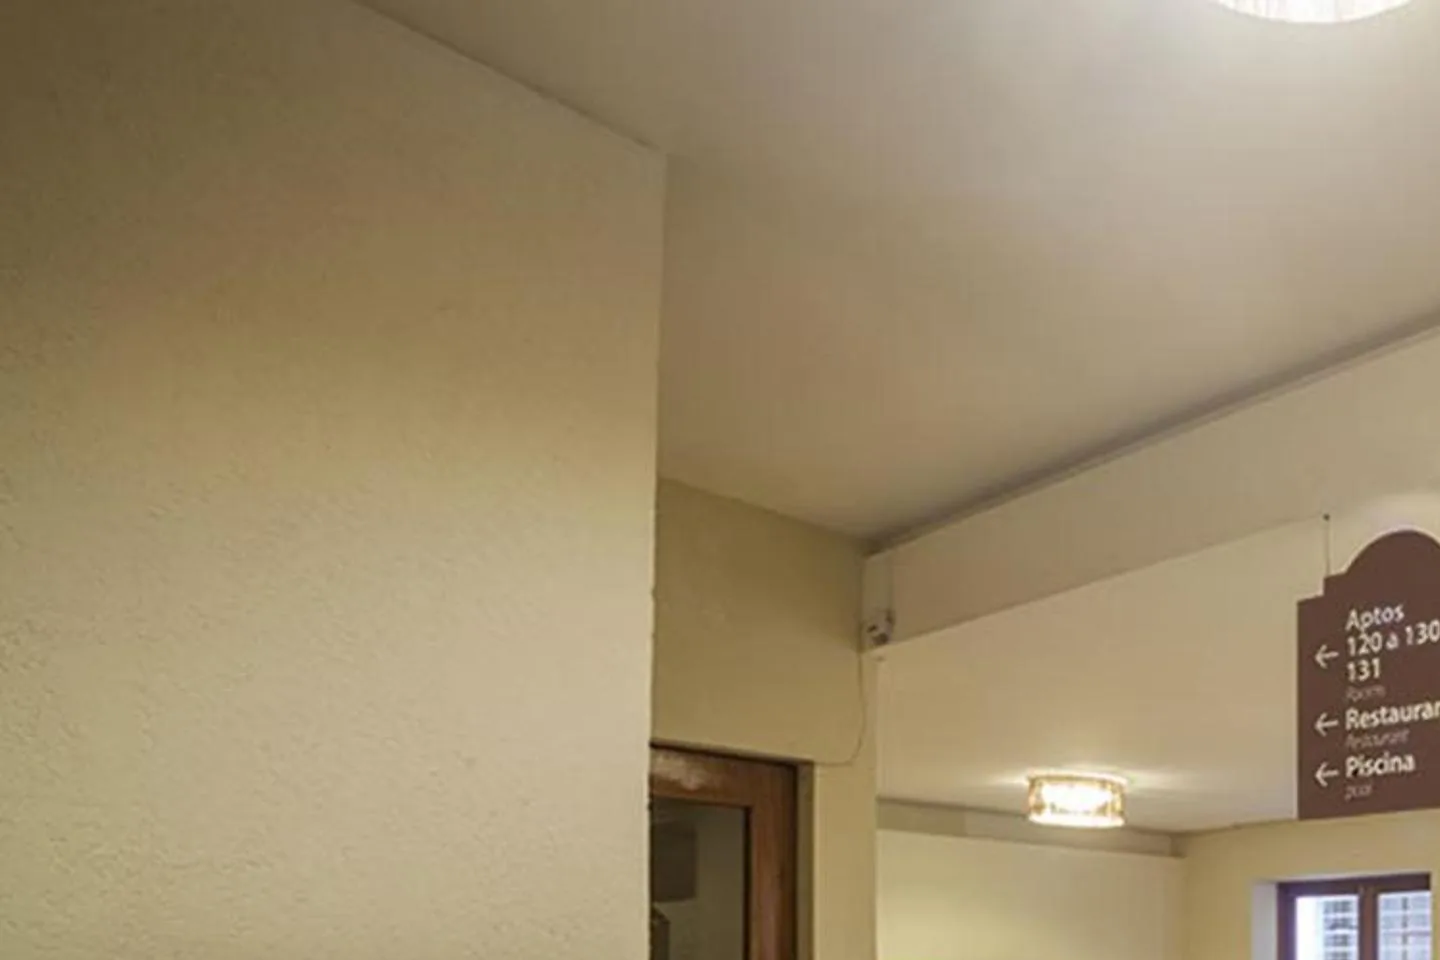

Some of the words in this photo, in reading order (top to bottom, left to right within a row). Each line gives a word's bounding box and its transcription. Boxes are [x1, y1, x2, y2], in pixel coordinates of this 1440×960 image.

[1345, 604, 1405, 633] Aptos
[1347, 631, 1383, 657] 120
[1347, 658, 1380, 682] 131
[1345, 751, 1416, 778] Piscina
